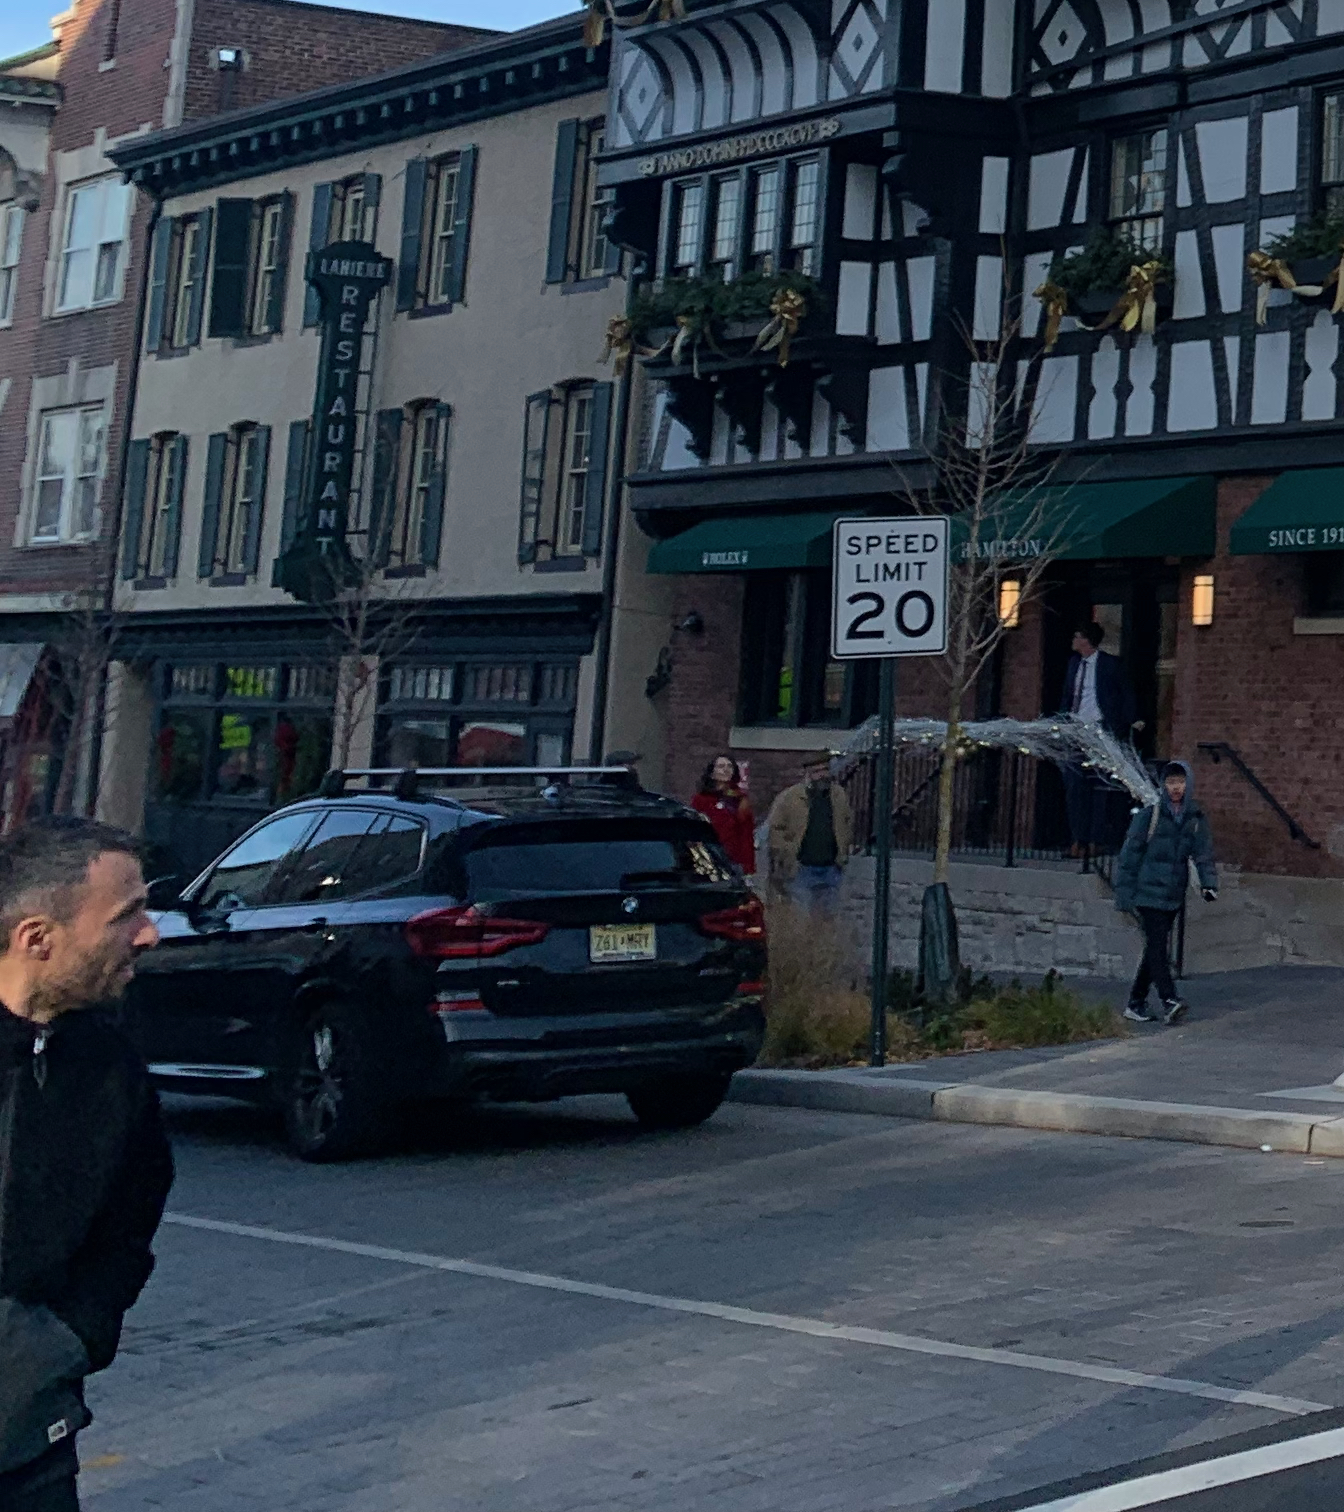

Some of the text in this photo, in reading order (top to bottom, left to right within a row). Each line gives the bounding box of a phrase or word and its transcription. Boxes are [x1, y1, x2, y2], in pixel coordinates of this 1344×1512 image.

[316, 285, 359, 556] RESTAURANT
[846, 533, 938, 556] SPEED
[1269, 528, 1316, 547] SINCE
[855, 561, 928, 584] LIMIT
[845, 589, 935, 640] 20
